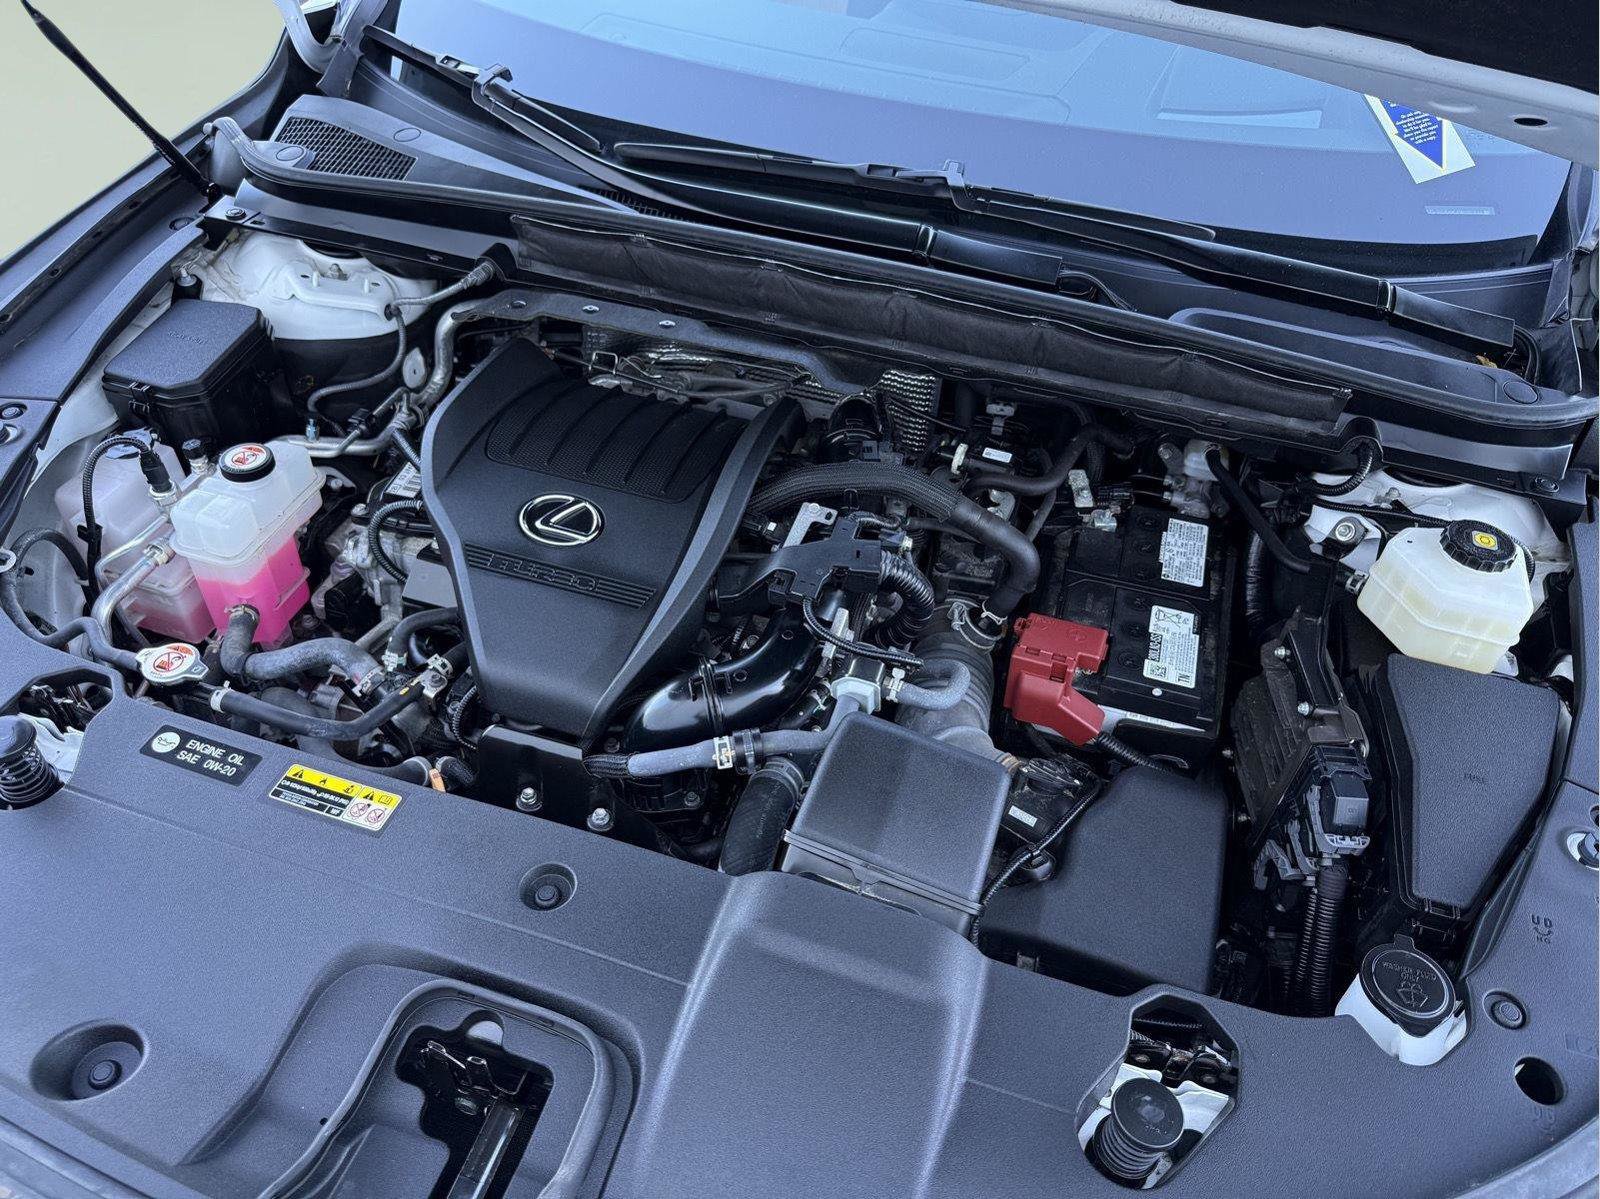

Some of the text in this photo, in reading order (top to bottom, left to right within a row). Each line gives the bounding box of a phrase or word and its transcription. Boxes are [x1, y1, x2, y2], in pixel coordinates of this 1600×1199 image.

[176, 750, 237, 777] SAE 0W-20
[185, 739, 244, 767] ENGINE OIL
